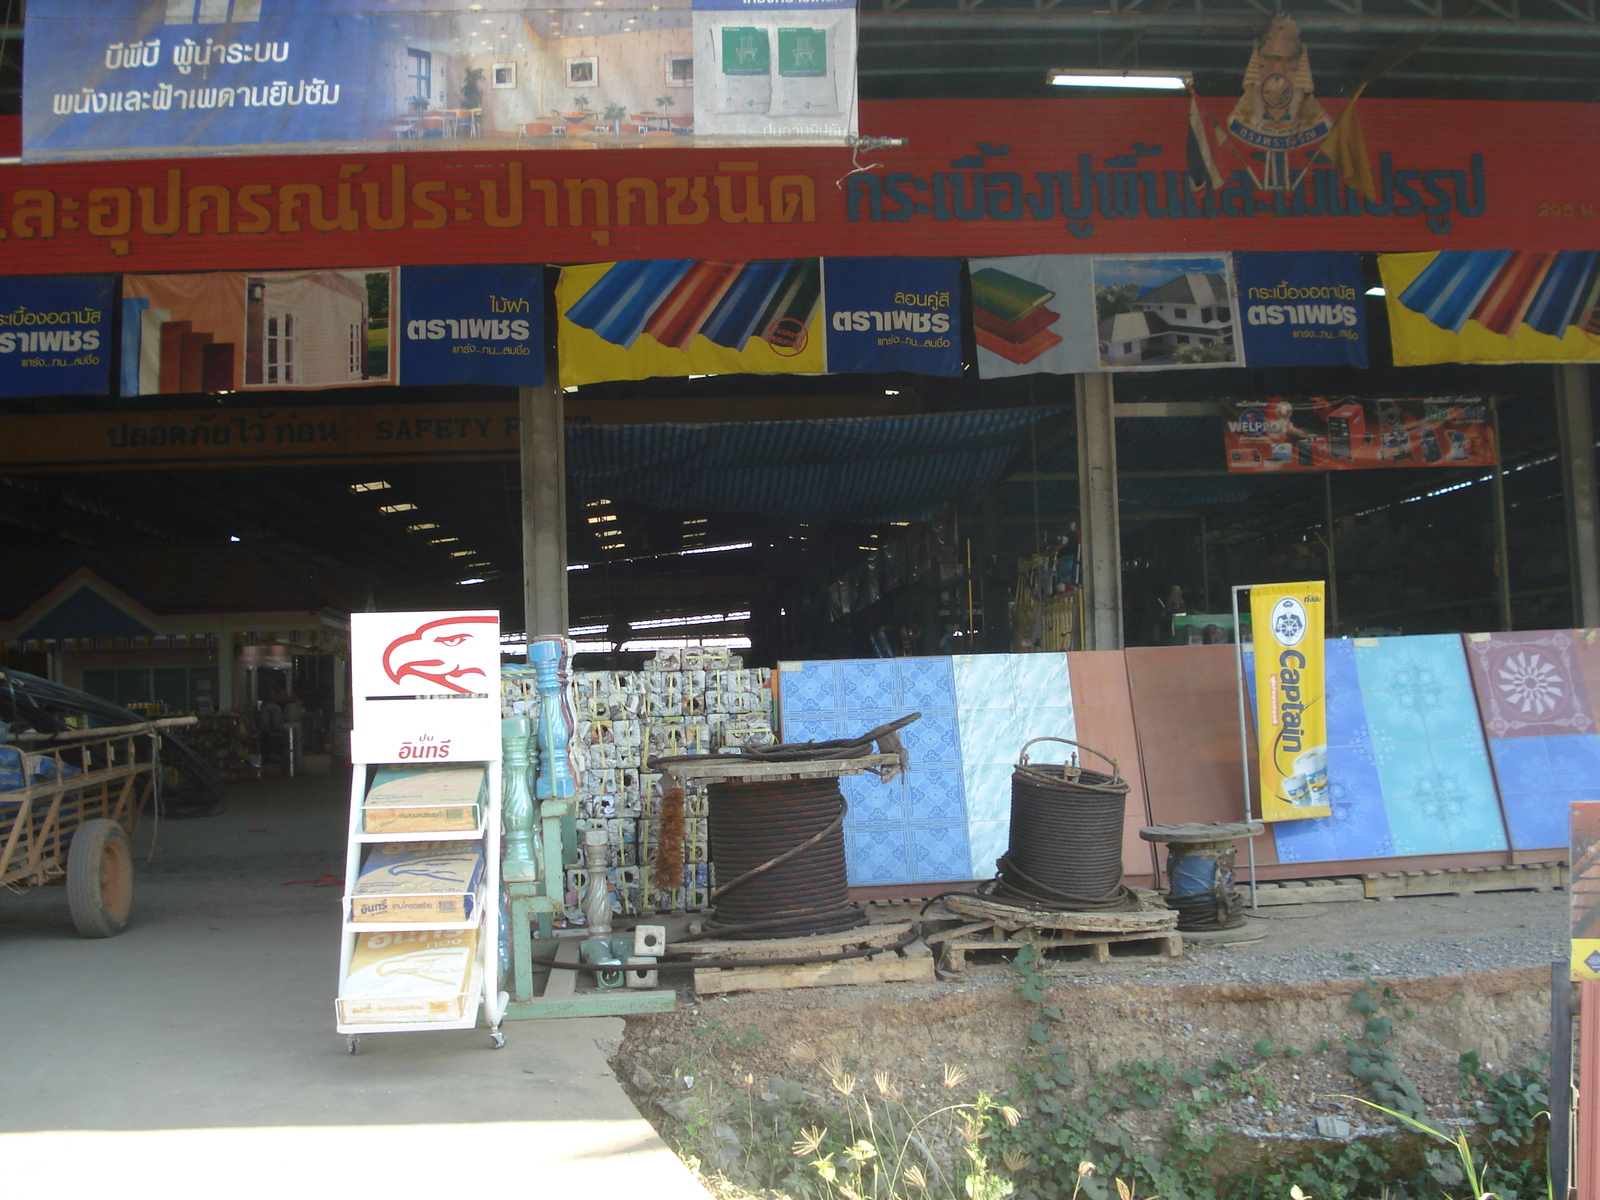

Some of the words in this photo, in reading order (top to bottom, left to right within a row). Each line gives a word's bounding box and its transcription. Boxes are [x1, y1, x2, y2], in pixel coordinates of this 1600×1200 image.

[173, 38, 290, 75] ผู้นำระบบ
[52, 78, 340, 116] ผนังและฝ้าเพดานยิปซัม
[0, 161, 815, 256] ละอุปกรณ์ประปาทุกชนิด
[489, 294, 530, 313] ไม้ฝา
[1247, 304, 1358, 326] ตราเพชร
[407, 318, 530, 340] ตราเพชร
[832, 310, 950, 333] ตราเพชร
[0, 330, 100, 353] ราเพชร
[375, 417, 493, 440] SAFETY
[1279, 649, 1305, 753] Captain
[398, 739, 451, 759] อินทรี
[361, 899, 388, 914] อินทรี
